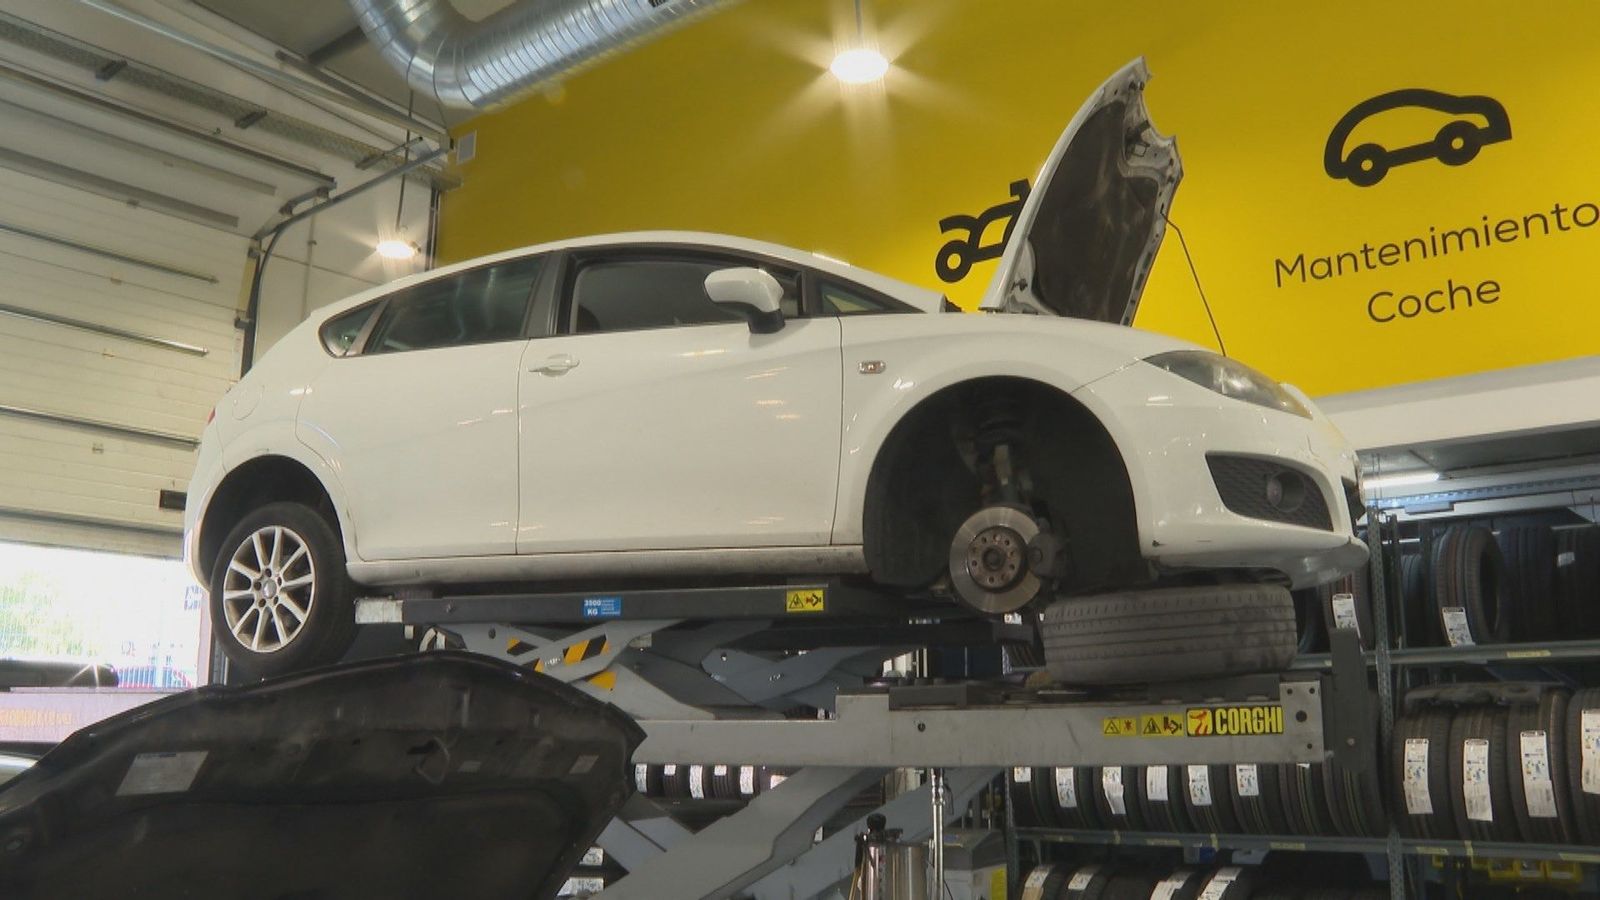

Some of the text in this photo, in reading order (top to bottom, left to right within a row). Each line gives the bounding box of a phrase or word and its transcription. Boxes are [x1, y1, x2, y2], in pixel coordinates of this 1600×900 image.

[1274, 203, 1600, 288] Mantenimiento
[1367, 279, 1501, 323] Coche
[1215, 706, 1284, 735] CORGHI
